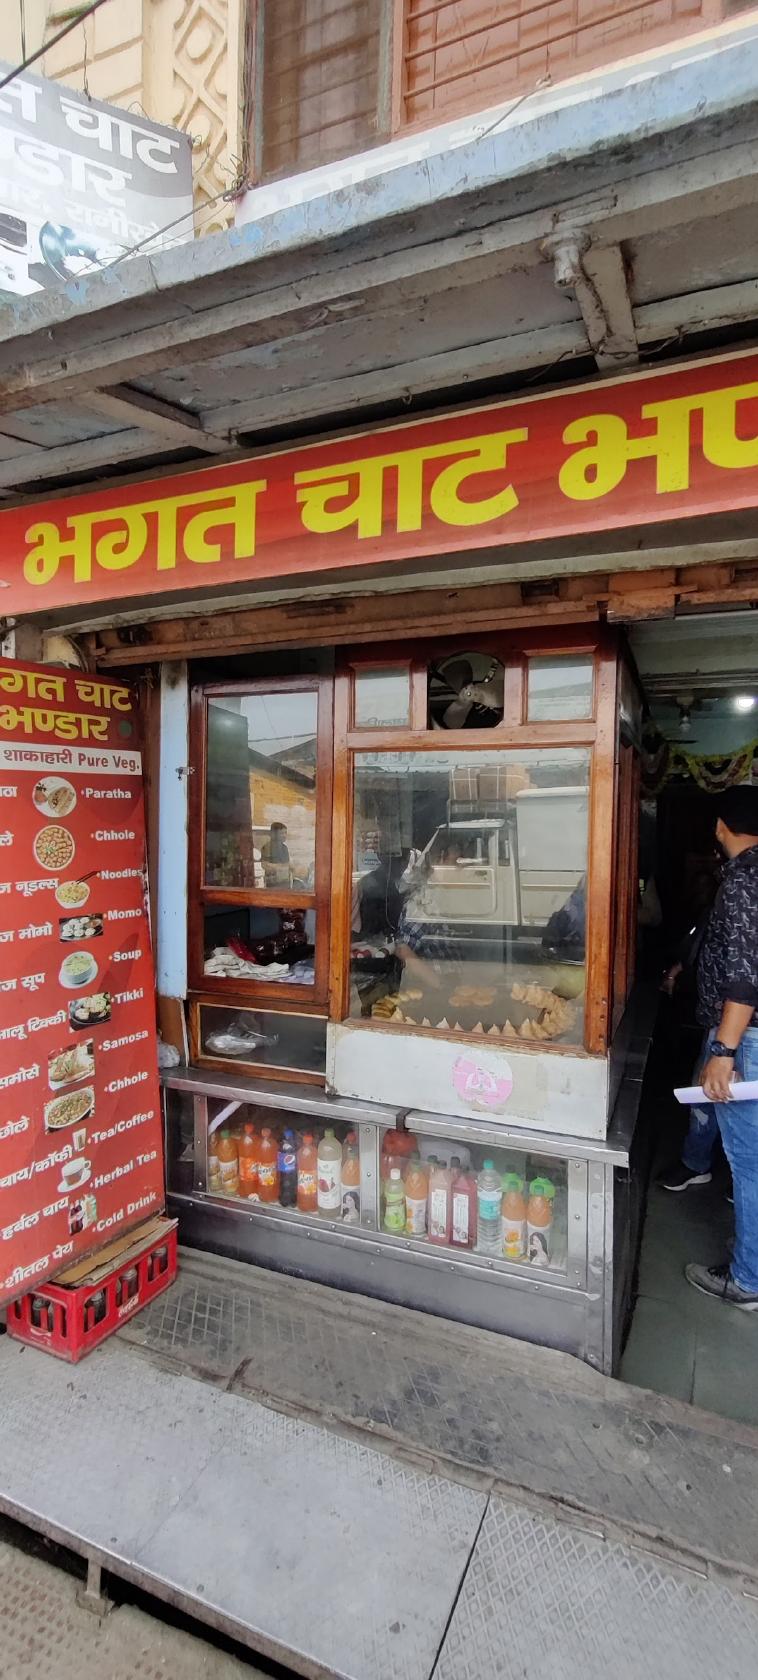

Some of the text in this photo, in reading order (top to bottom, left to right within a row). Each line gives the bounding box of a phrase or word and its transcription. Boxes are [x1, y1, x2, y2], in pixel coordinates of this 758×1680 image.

[60, 96, 180, 174] चाट
[23, 480, 266, 586] भगत
[294, 427, 529, 539] चाट
[75, 679, 132, 711] चाट
[0, 704, 111, 740] भण्डार
[4, 749, 72, 764] शाकाहारी
[78, 753, 140, 772] Pure Veg.
[85, 787, 132, 799] Paratha
[95, 830, 136, 841] Chhole
[100, 868, 143, 880] Noodles
[15, 878, 60, 897] नूडल्स
[107, 908, 143, 921] Momo
[18, 921, 53, 940] मोमो
[113, 948, 142, 962] Soup
[20, 972, 46, 991] सूप
[114, 987, 144, 1004] Tikki
[27, 1010, 68, 1033] टिक्की
[102, 1030, 149, 1052] Samosa
[108, 1071, 149, 1093] Chhole
[92, 1110, 154, 1144] Tea/Coffee
[94, 1150, 158, 1189] Herbal Tea
[42, 1194, 70, 1217] चाय
[96, 1191, 158, 1233] Cold Drink
[4, 1240, 74, 1288] शीतल पेय
